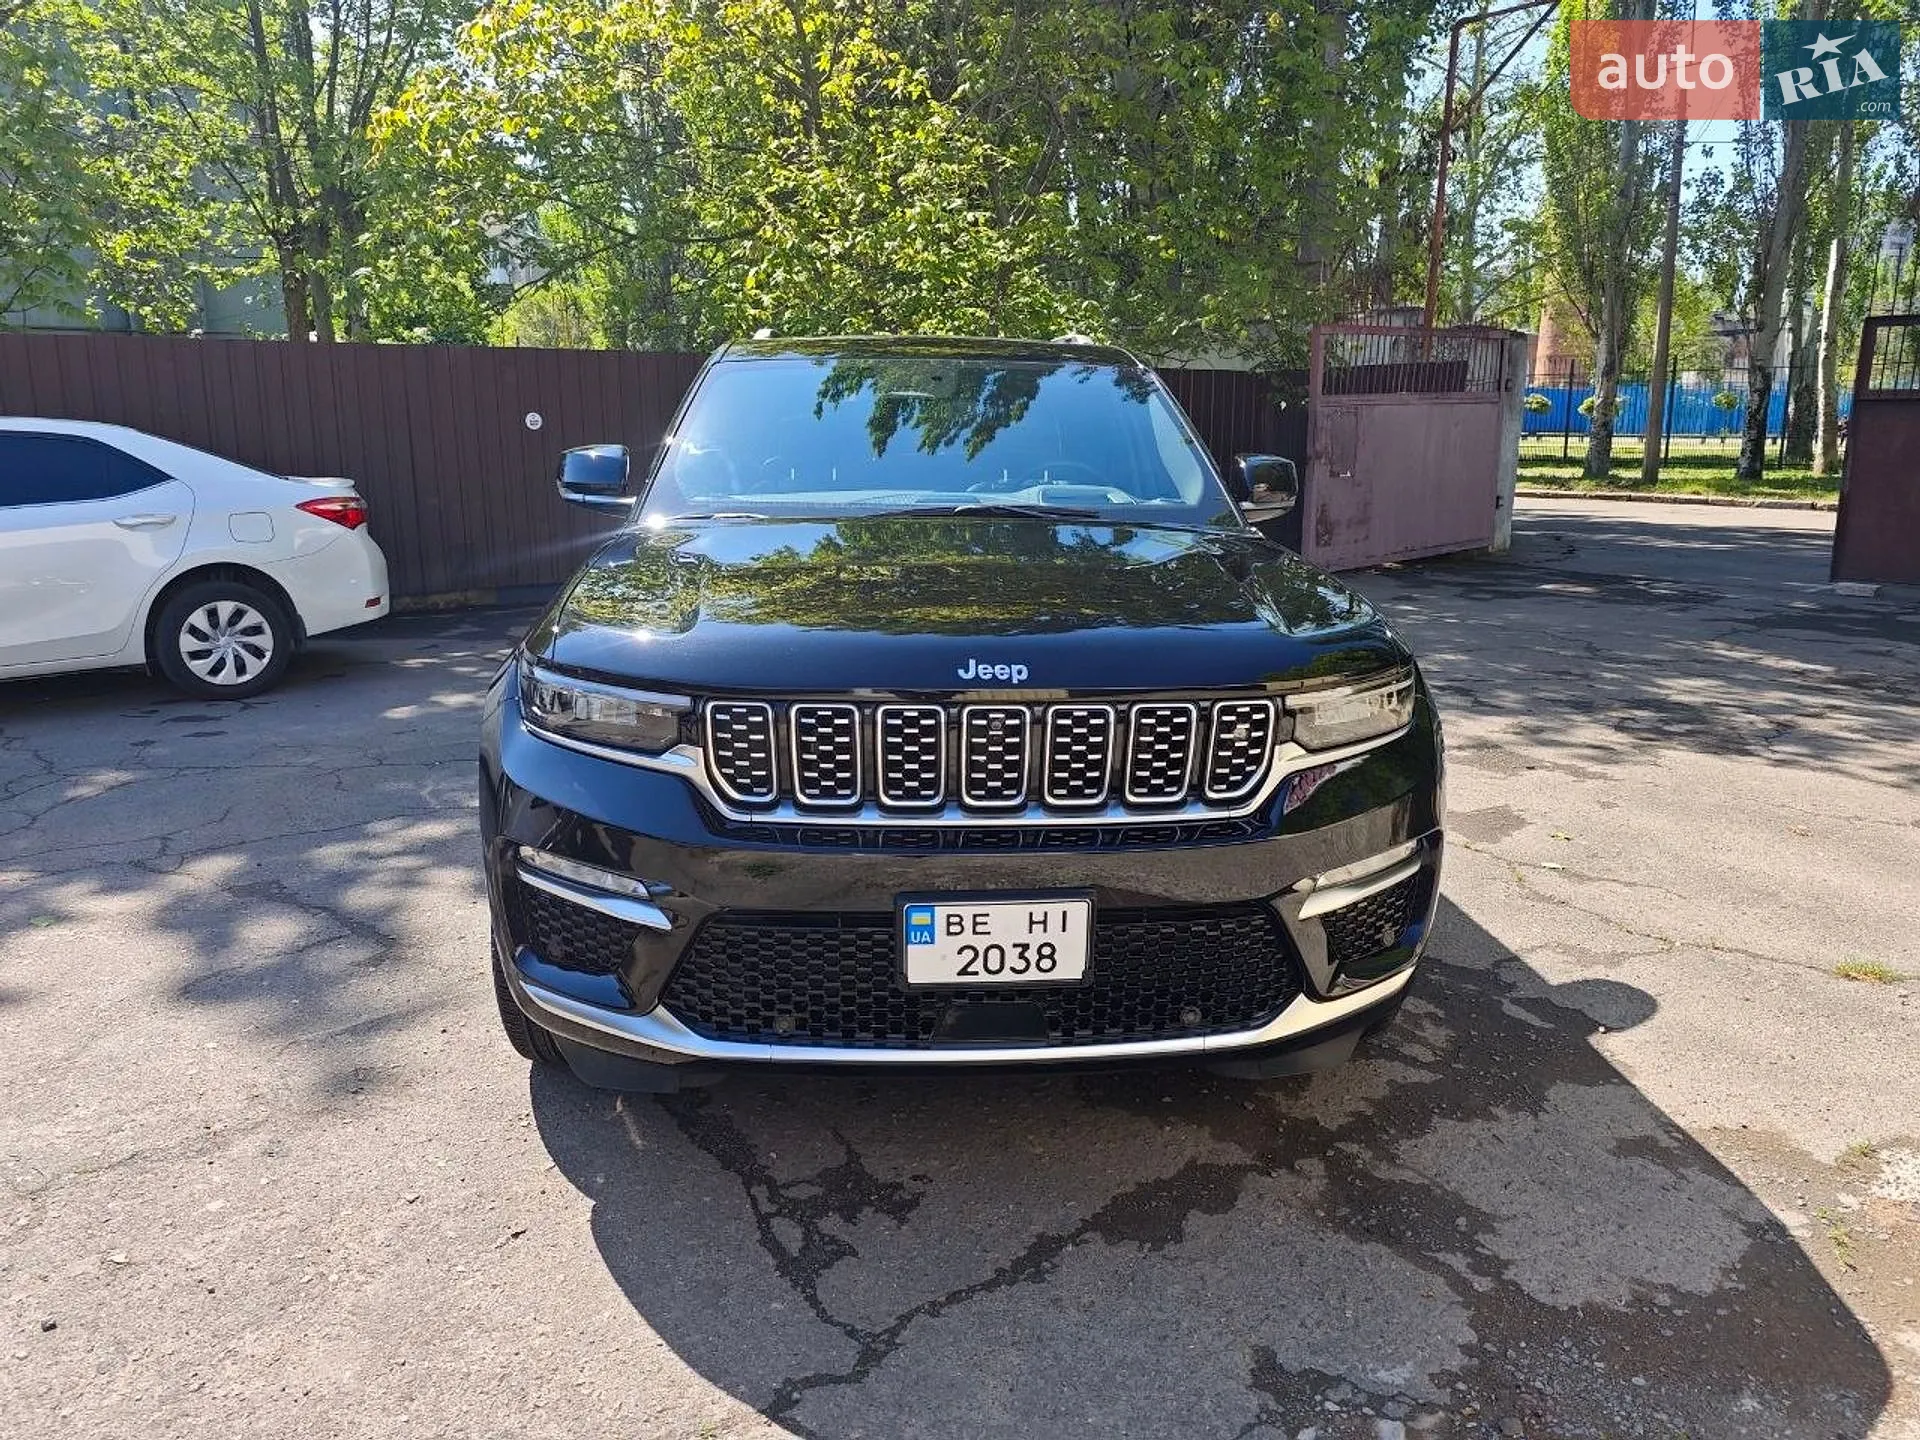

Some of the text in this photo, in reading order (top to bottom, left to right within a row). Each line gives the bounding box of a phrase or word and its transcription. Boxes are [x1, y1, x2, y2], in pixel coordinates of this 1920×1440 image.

[957, 658, 1029, 684] Jeep
[946, 910, 1068, 936] BE HI
[911, 932, 931, 943] UA
[956, 942, 1058, 976] 2038
